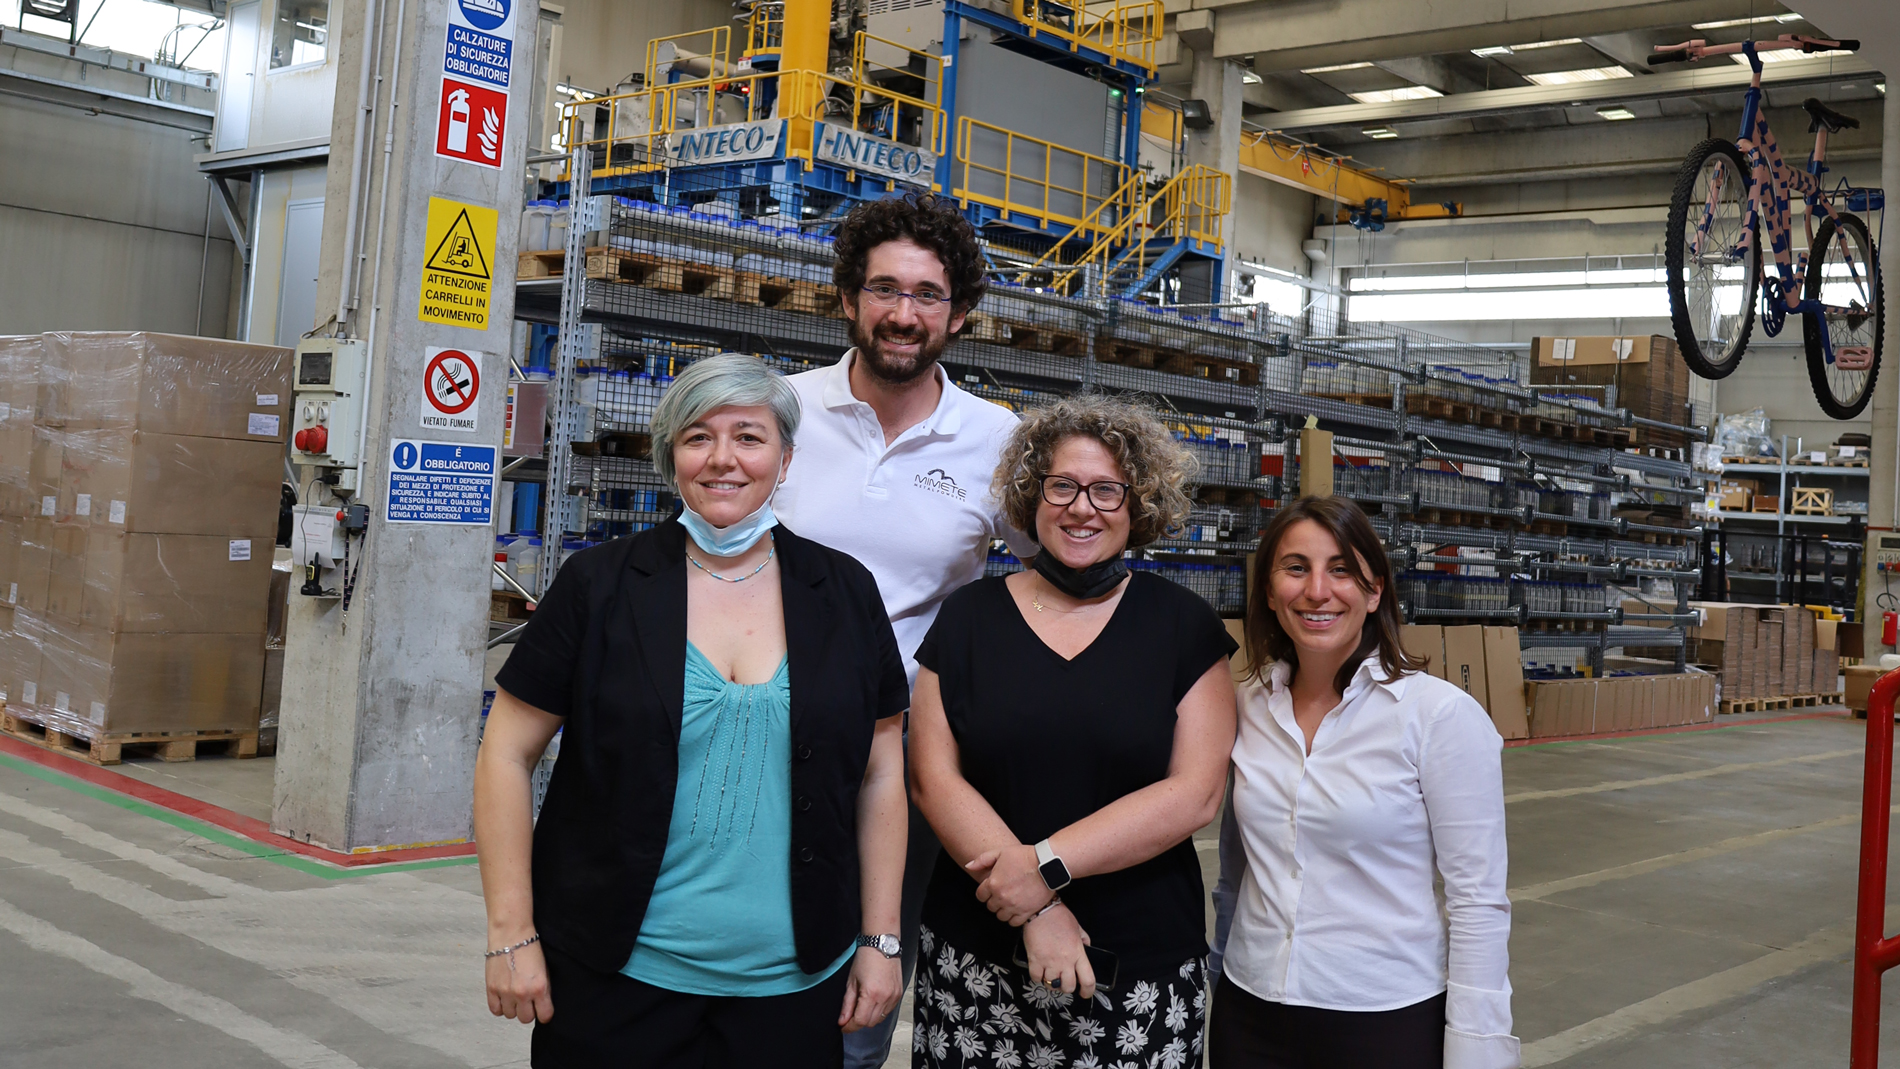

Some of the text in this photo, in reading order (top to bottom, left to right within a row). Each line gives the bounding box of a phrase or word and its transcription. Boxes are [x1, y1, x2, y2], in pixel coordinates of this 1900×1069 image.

[454, 29, 507, 54] CALZATURE
[447, 42, 509, 69] DI SICUREZZA
[446, 57, 508, 83] OBBLIGATORIE
[427, 273, 487, 292] ATTENZIONE
[425, 289, 486, 308] CARRELLI IN
[423, 305, 484, 324] MOVIMENTO
[423, 416, 475, 429] VIETATO FUMARE
[424, 459, 490, 472] OBBLIGATORIO
[392, 474, 428, 482] SEGNALARE
[429, 476, 451, 484] DIFETTI
[441, 484, 479, 492] PROTEZIONE
[914, 474, 966, 498] MIMETE
[399, 496, 483, 507] RESPONSABILE QUALSIASI
[433, 491, 460, 499] INDICARE
[461, 492, 482, 500] SUBITO
[434, 505, 463, 513] PERICOLO
[419, 512, 462, 520] CONOSCENZA
